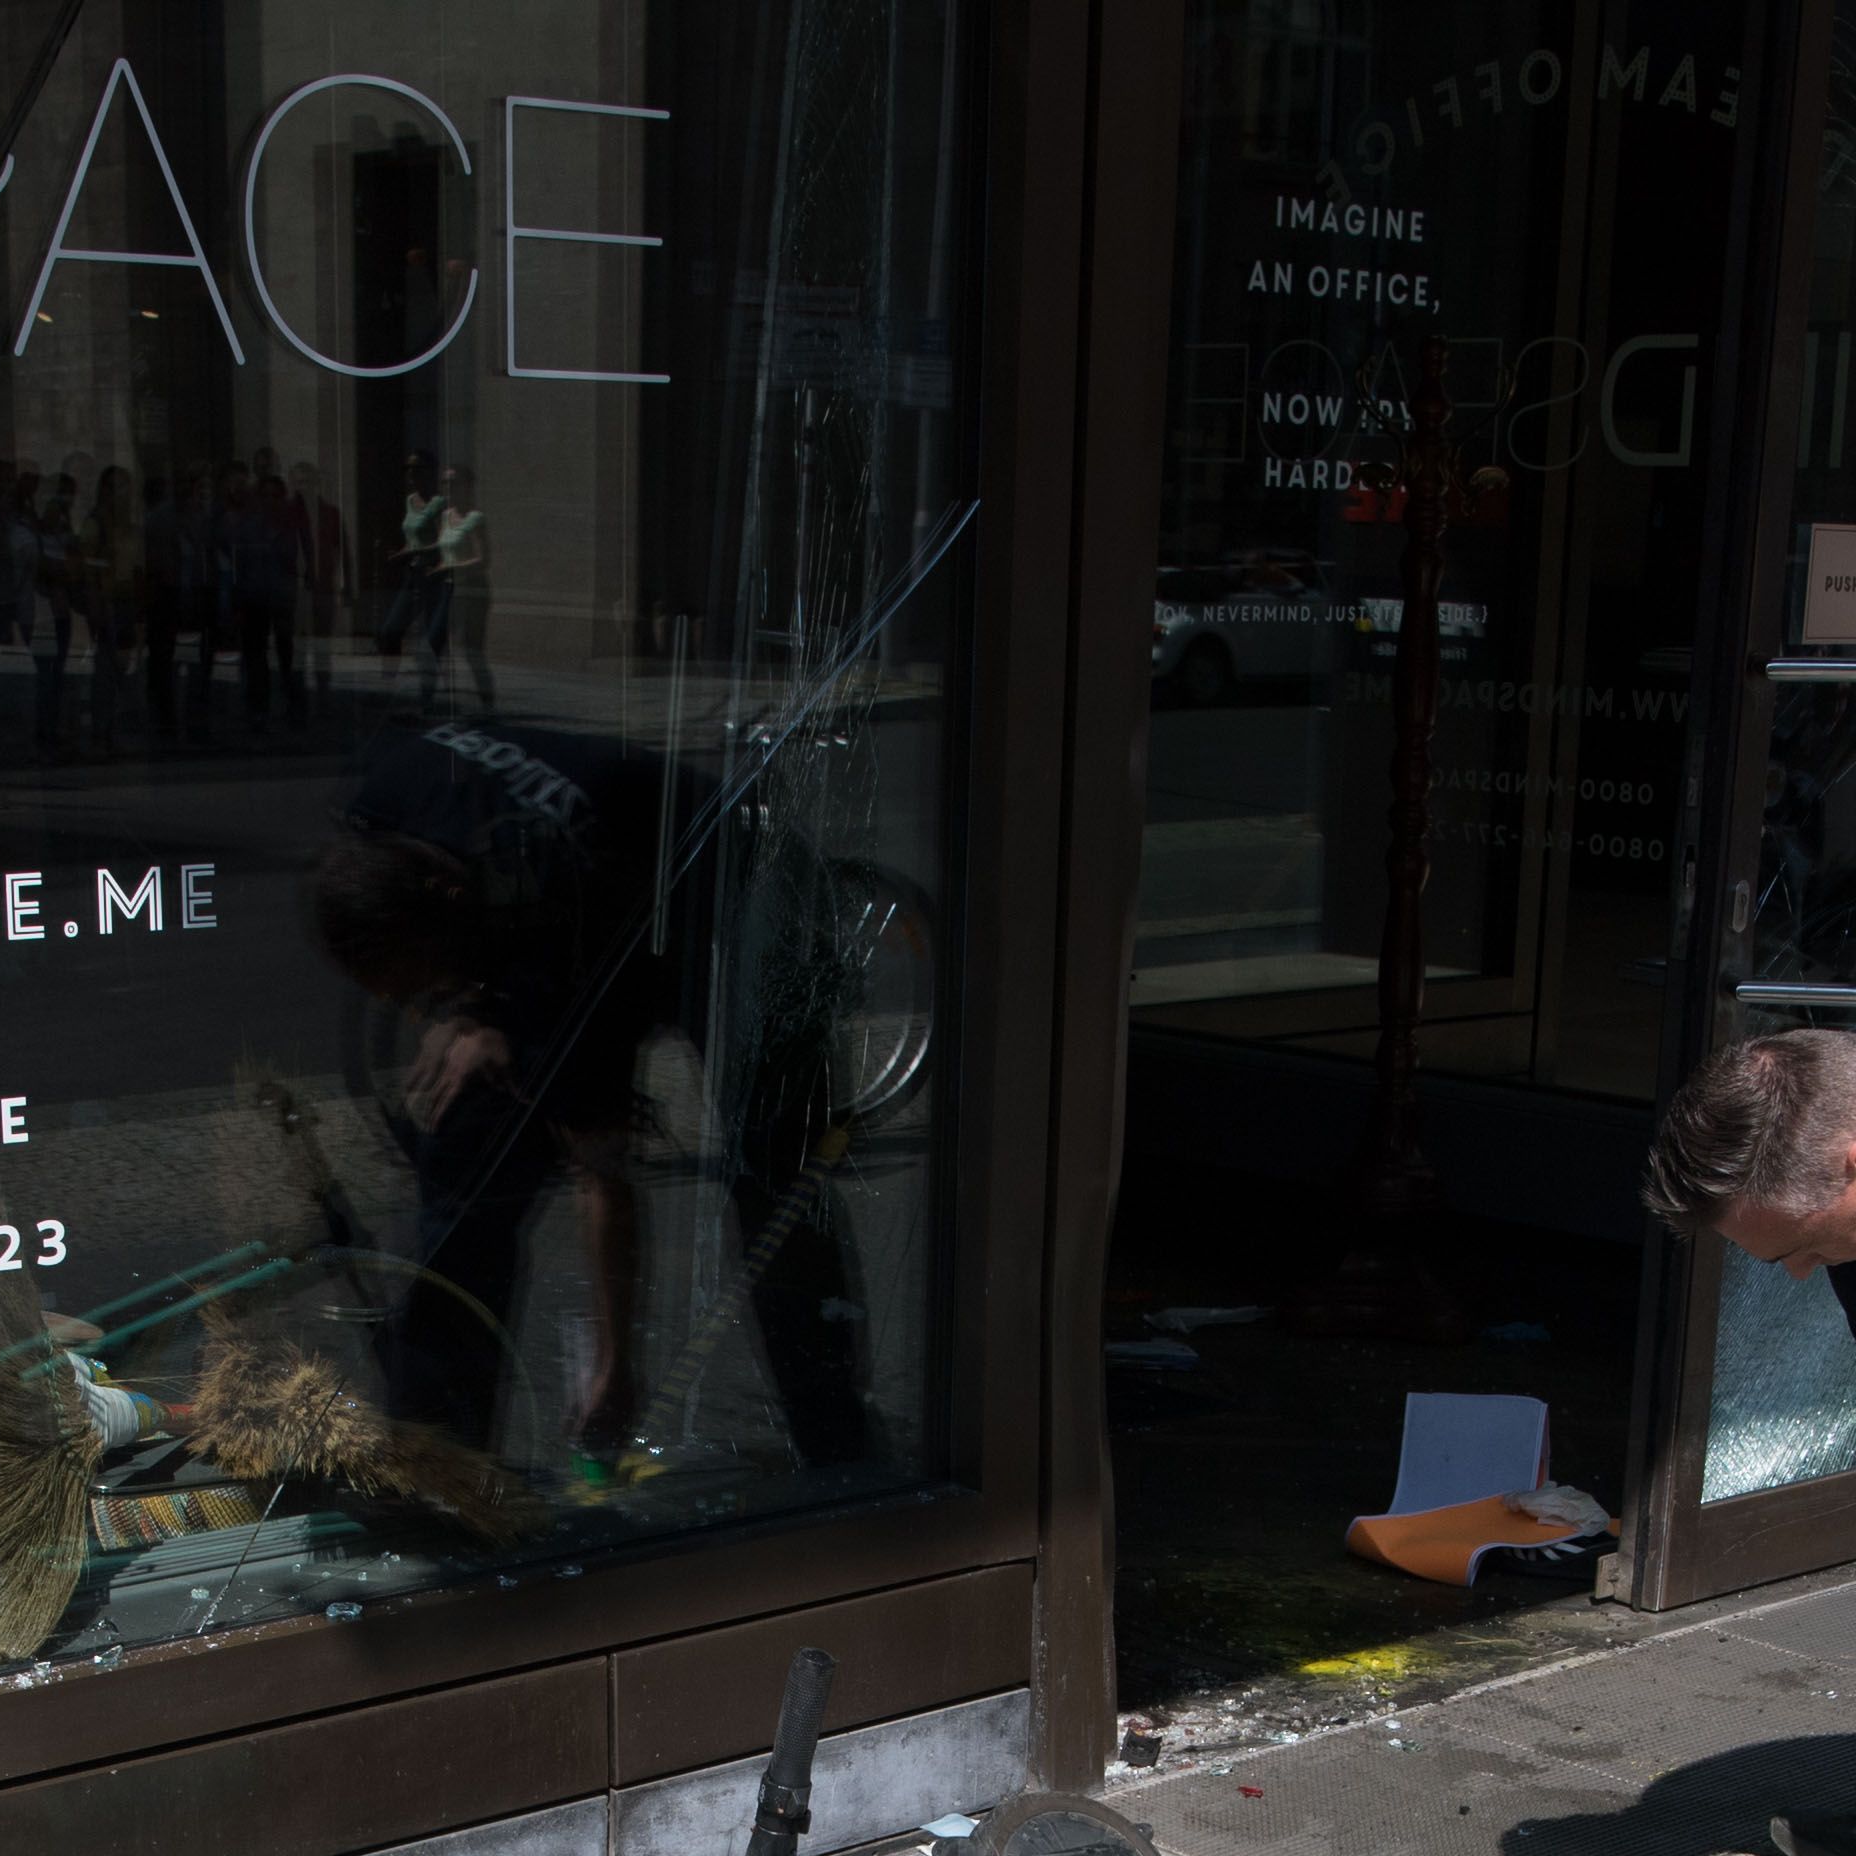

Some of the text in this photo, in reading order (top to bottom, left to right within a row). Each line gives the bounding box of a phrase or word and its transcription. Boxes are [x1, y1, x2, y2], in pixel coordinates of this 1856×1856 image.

[1274, 196, 1427, 245] IMAGINE
[1247, 259, 1442, 315] AN OFFICE,
[1262, 391, 1343, 428] NOW
[1202, 604, 1318, 626] NEVERMIND,
